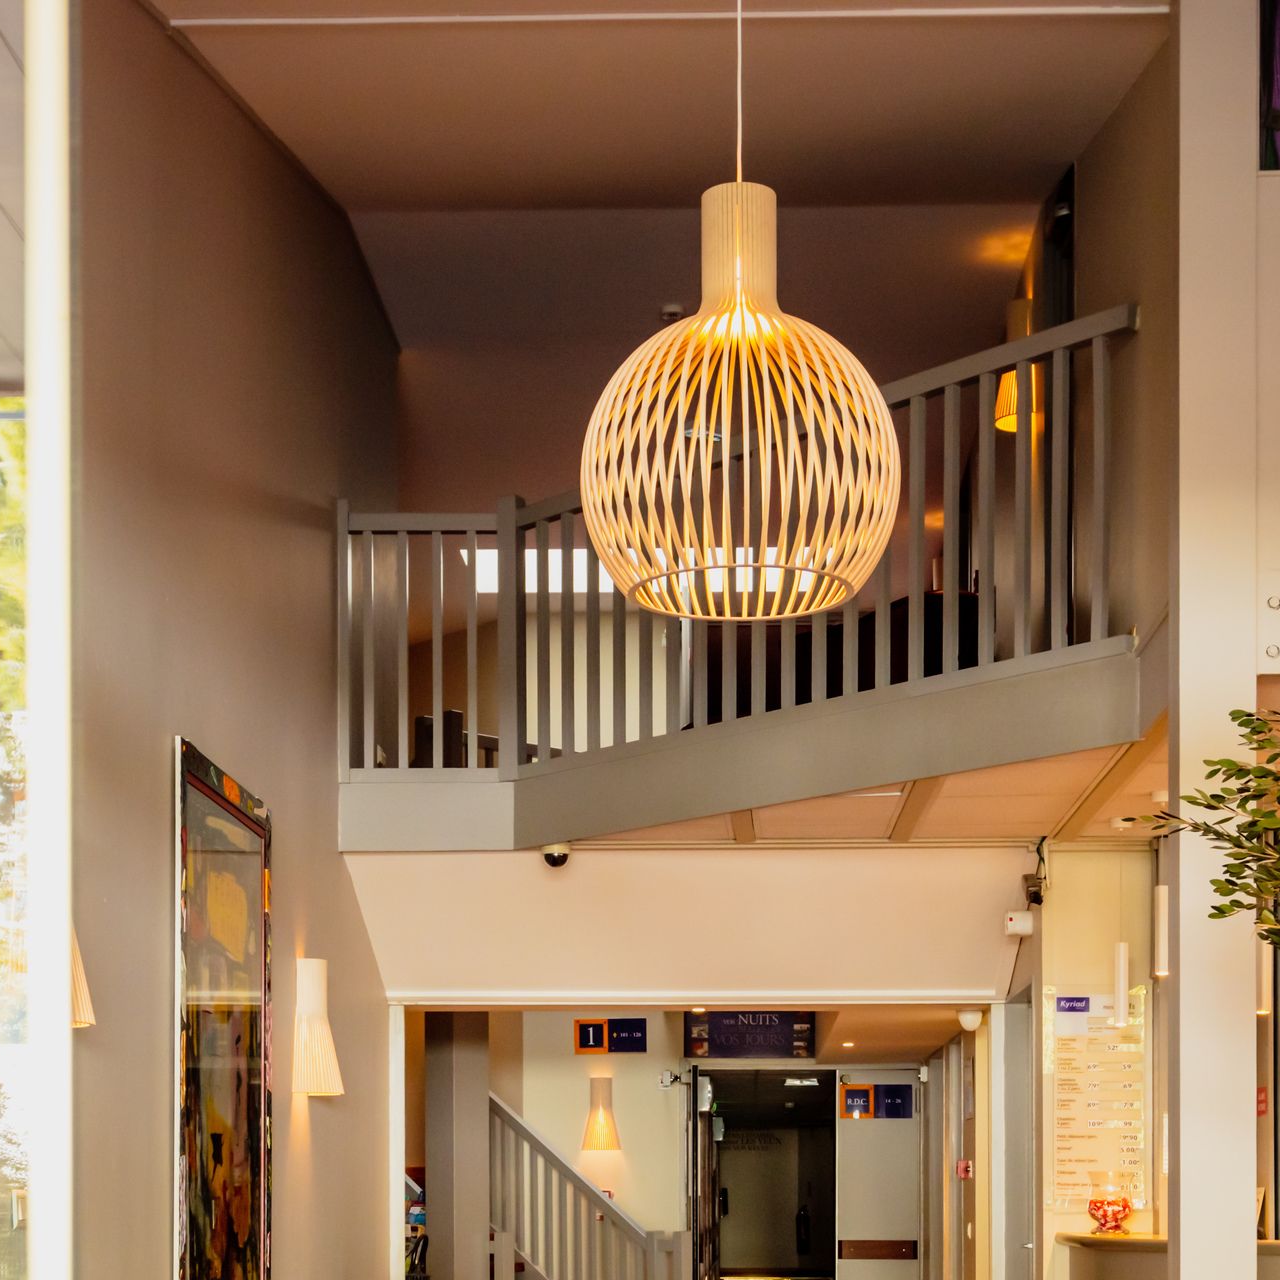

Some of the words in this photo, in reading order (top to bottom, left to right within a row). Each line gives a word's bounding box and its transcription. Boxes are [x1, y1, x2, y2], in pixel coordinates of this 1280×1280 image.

[1060, 1000, 1085, 1010] Kyriad
[738, 1014, 779, 1025] NUITS
[587, 1026, 595, 1045] 1
